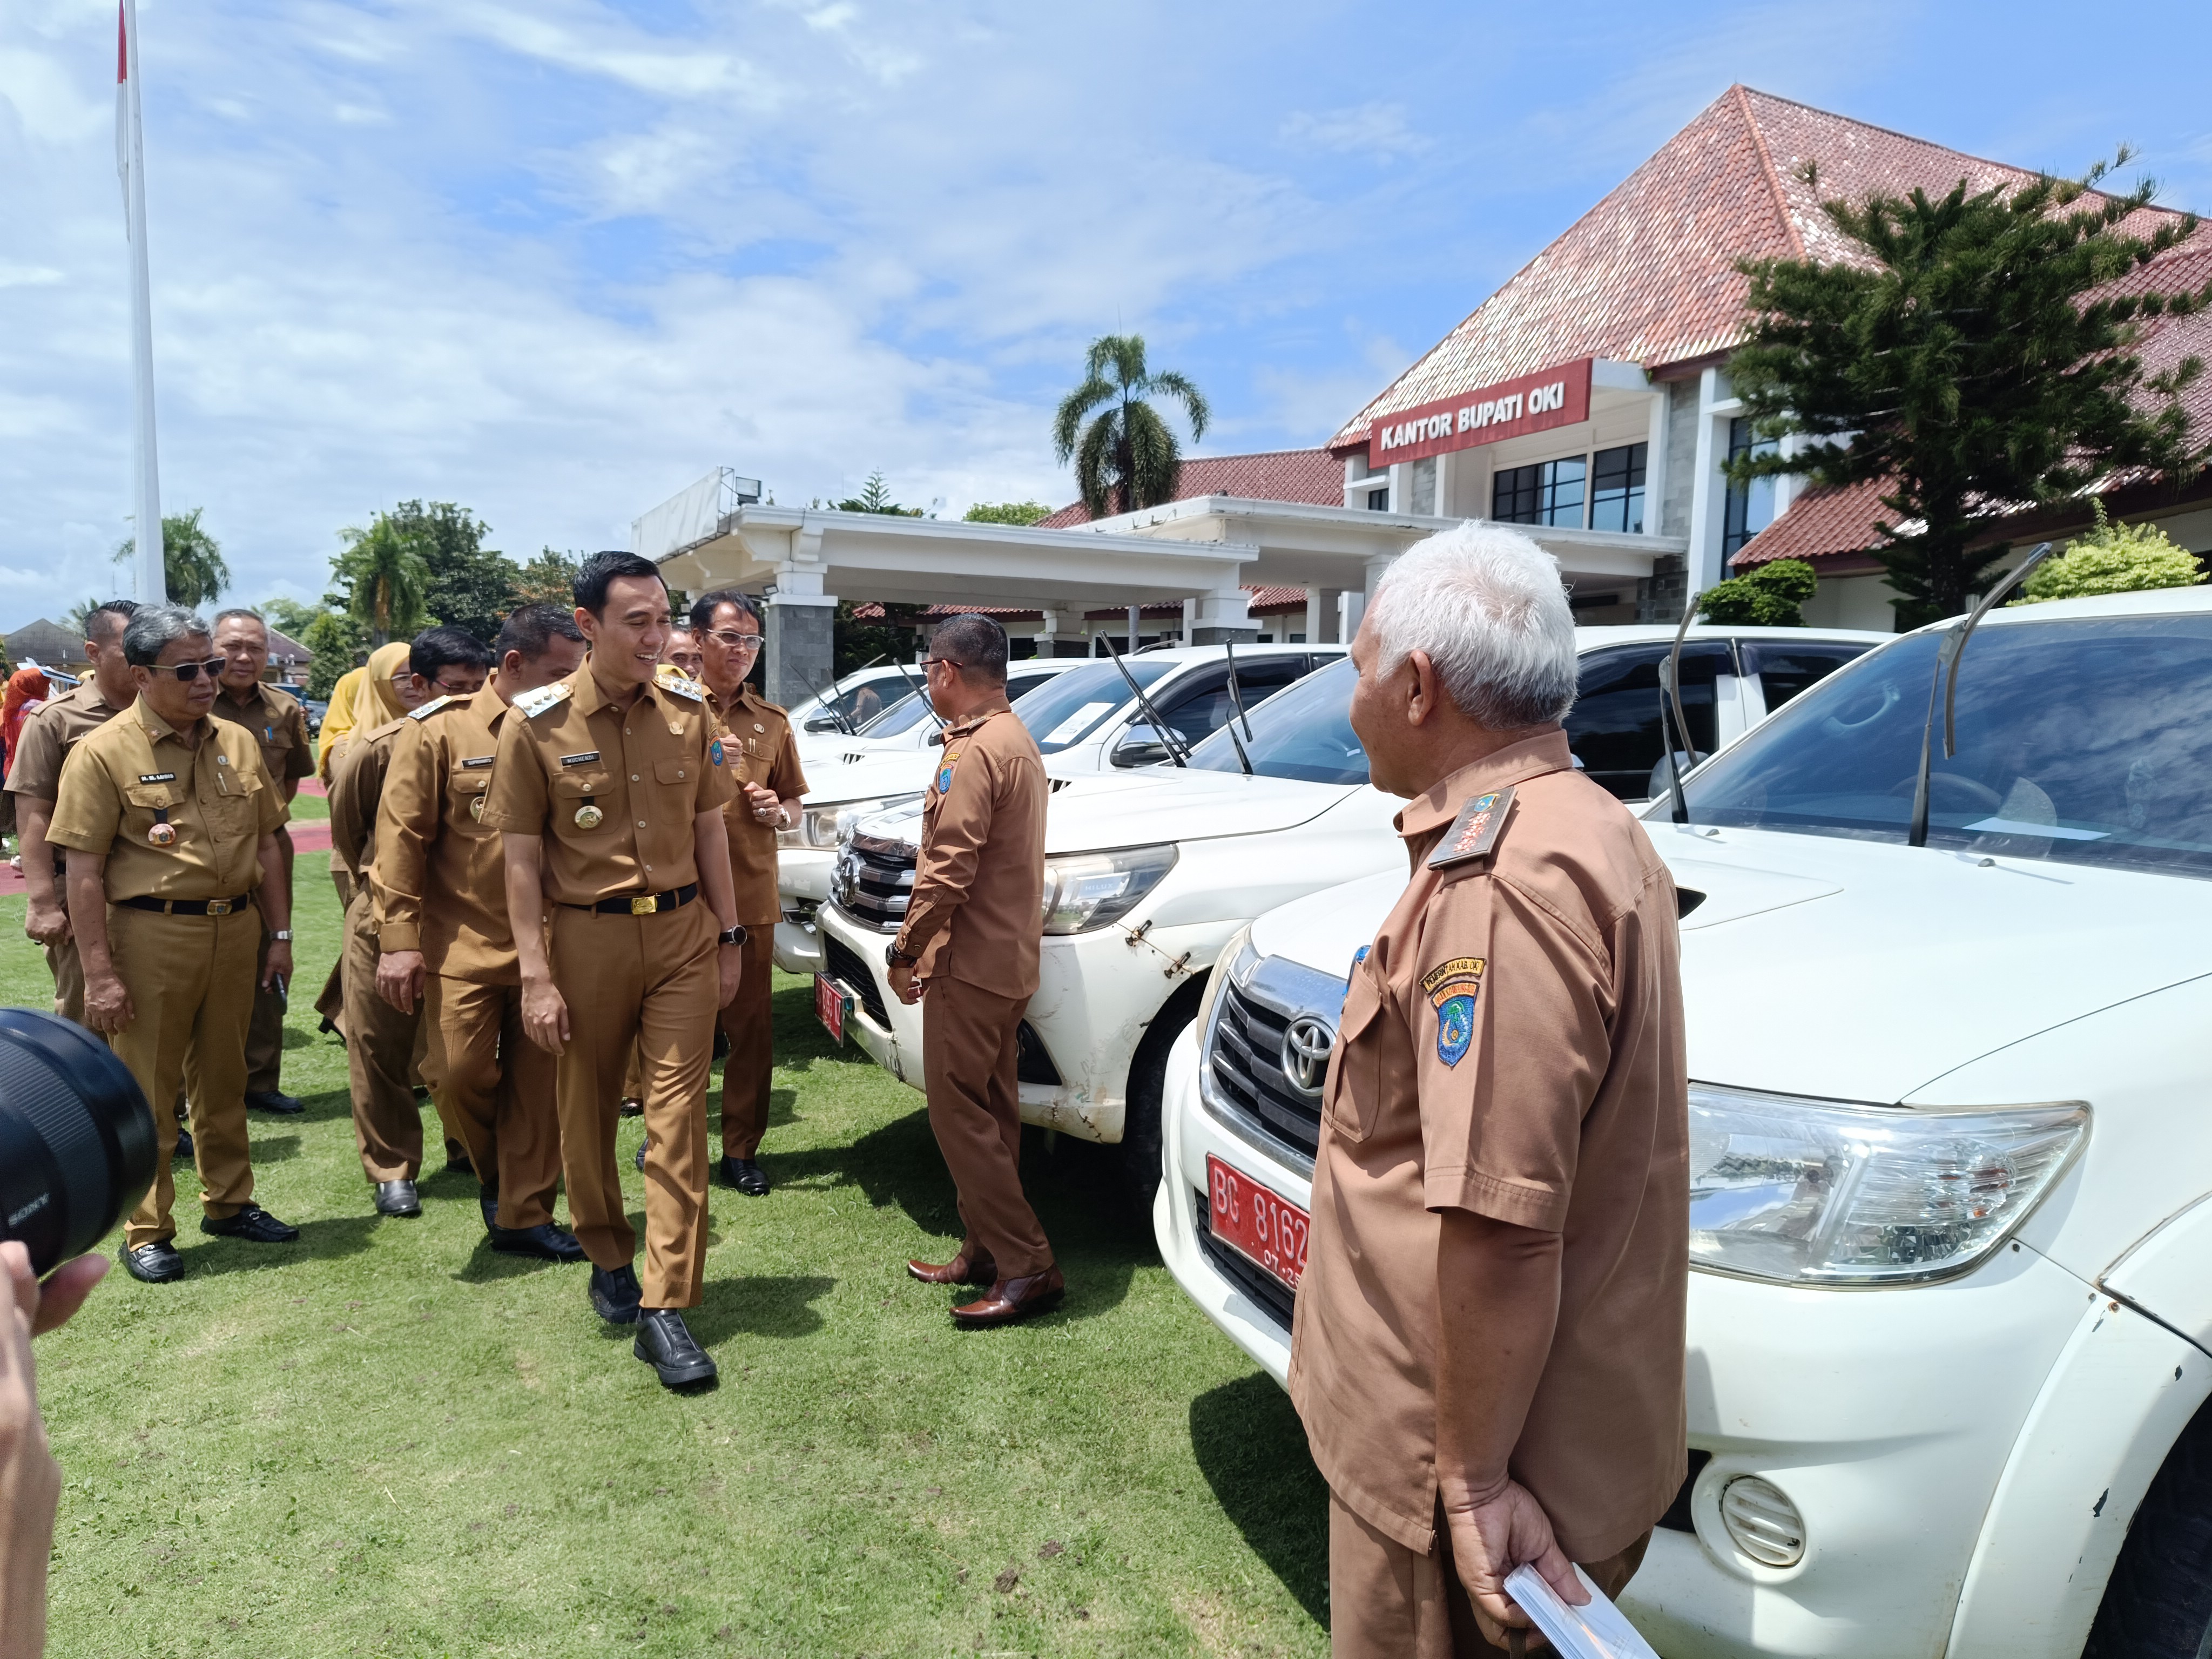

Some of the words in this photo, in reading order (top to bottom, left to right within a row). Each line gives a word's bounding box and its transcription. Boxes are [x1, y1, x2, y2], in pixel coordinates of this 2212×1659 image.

[1381, 411, 1453, 451] KANTOR
[1458, 392, 1523, 433] BUPATI
[1528, 381, 1564, 414] OKI
[567, 754, 594, 764] MUCHENDI
[1215, 1166, 1239, 1223] BG
[1254, 1193, 1307, 1267] 8162
